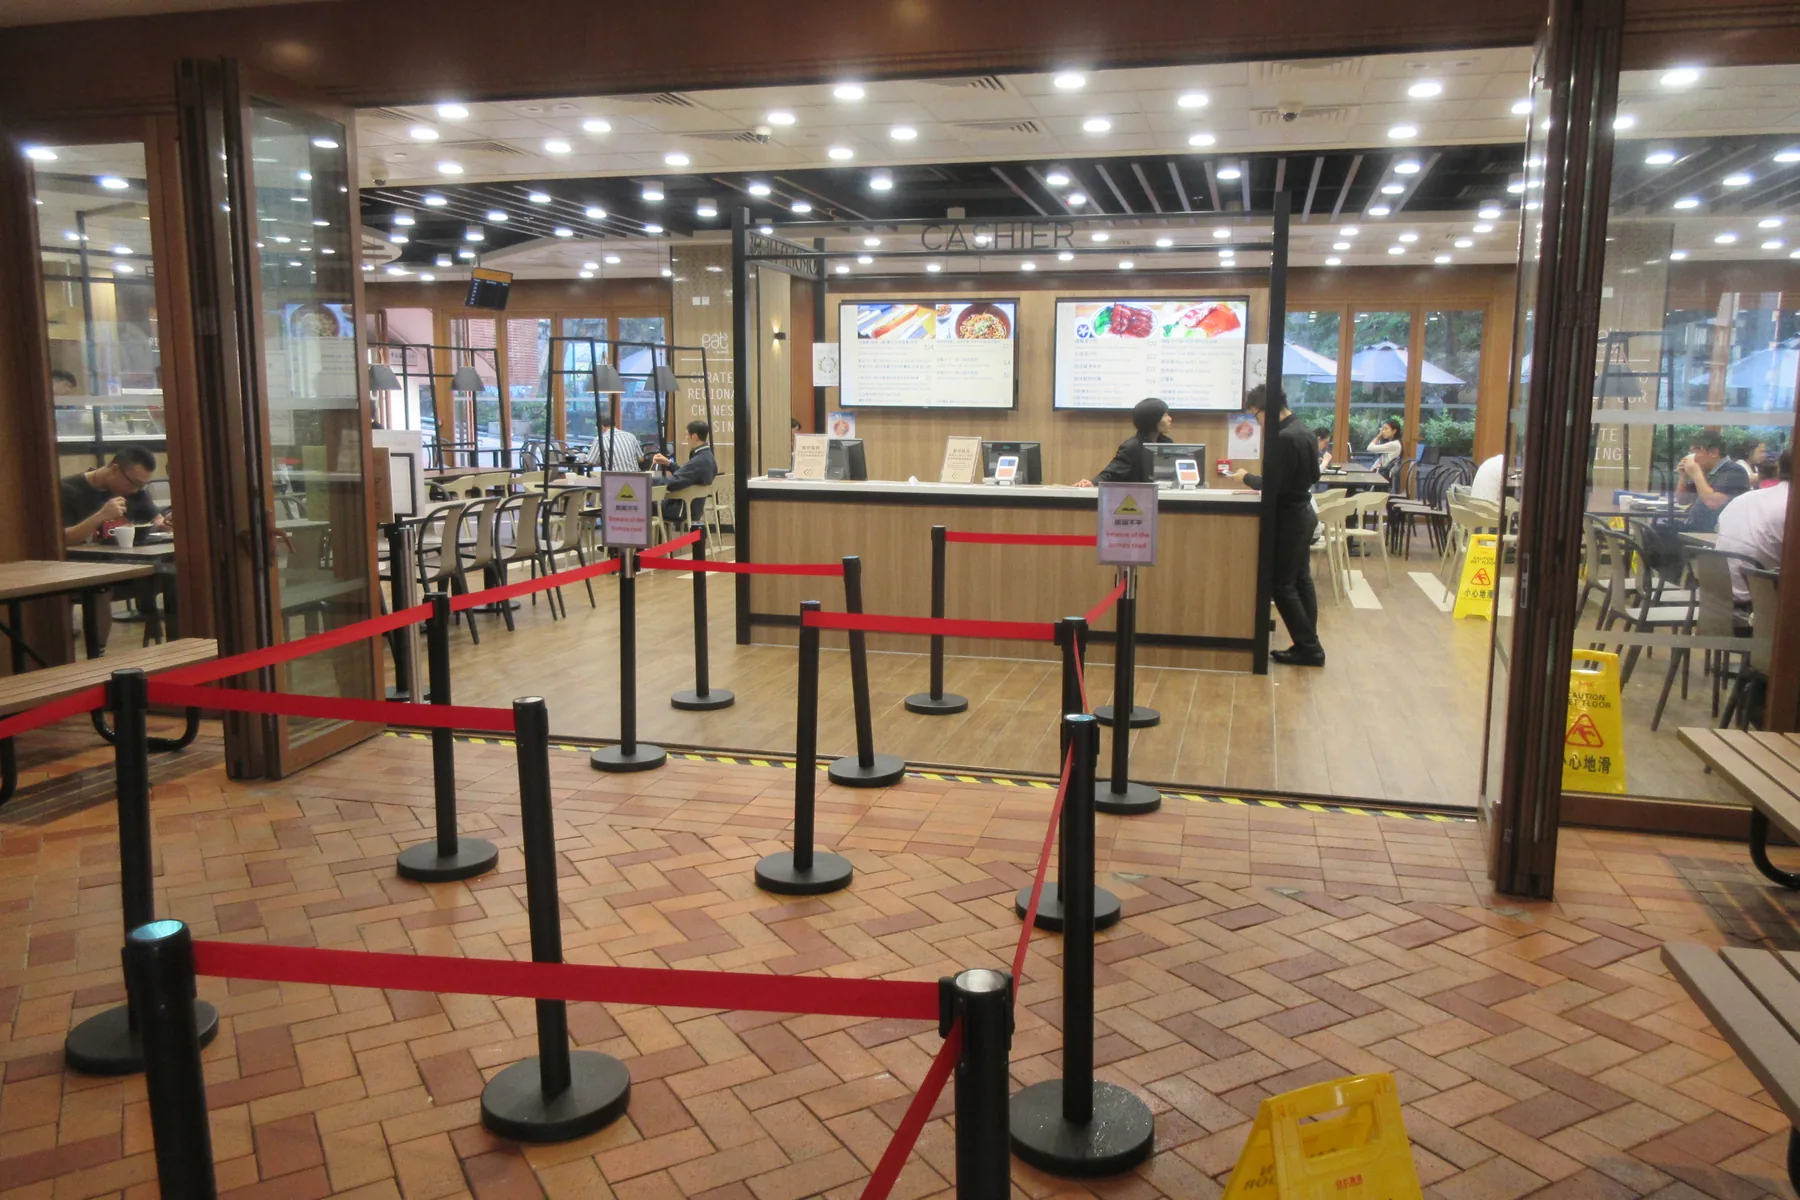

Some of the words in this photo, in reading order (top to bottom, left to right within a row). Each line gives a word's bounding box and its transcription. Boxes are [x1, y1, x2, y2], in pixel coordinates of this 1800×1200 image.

[922, 222, 1074, 250] CASHIER
[691, 372, 733, 383] CURATE
[688, 389, 734, 400] REGION
[691, 405, 734, 416] CHNES
[1582, 699, 1611, 709] FLOOR
[1563, 755, 1611, 774] 心地滑
